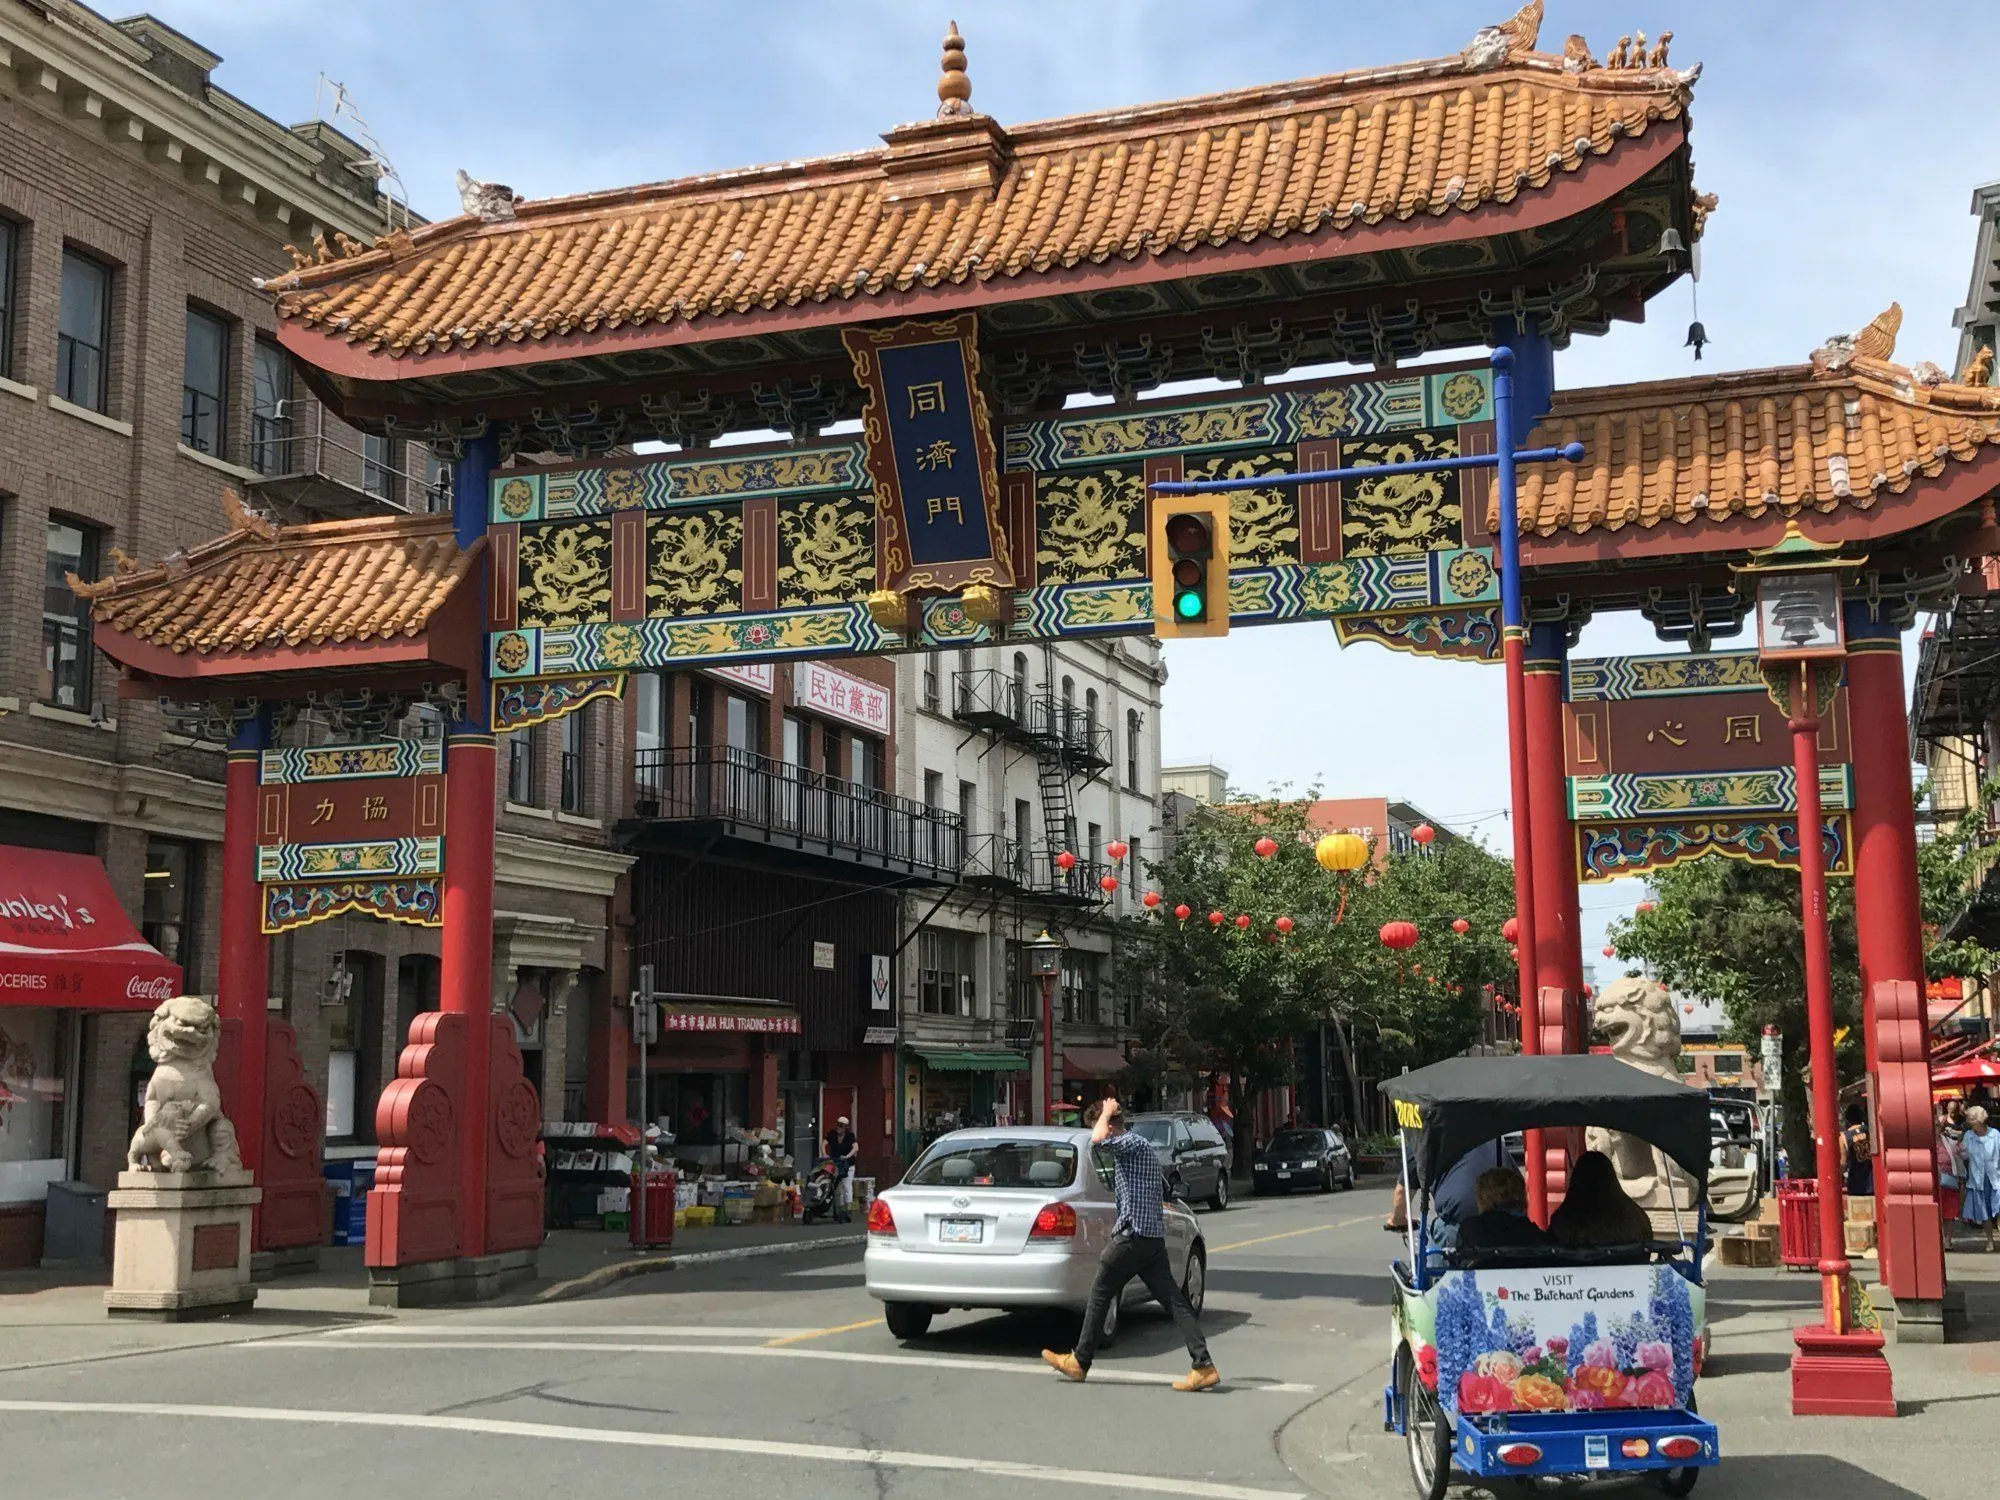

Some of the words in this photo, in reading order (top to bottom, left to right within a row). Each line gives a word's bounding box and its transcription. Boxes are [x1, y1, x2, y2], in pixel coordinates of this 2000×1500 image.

[908, 381, 964, 526] 同濟門
[811, 670, 883, 723] 民治黨部
[719, 1016, 735, 1030] HUA
[737, 1017, 767, 1031] TRADING
[1542, 1274, 1574, 1286] VISIT
[1510, 1290, 1530, 1301] The
[1533, 1287, 1585, 1301] Butchart
[1587, 1287, 1635, 1302] Gardens
